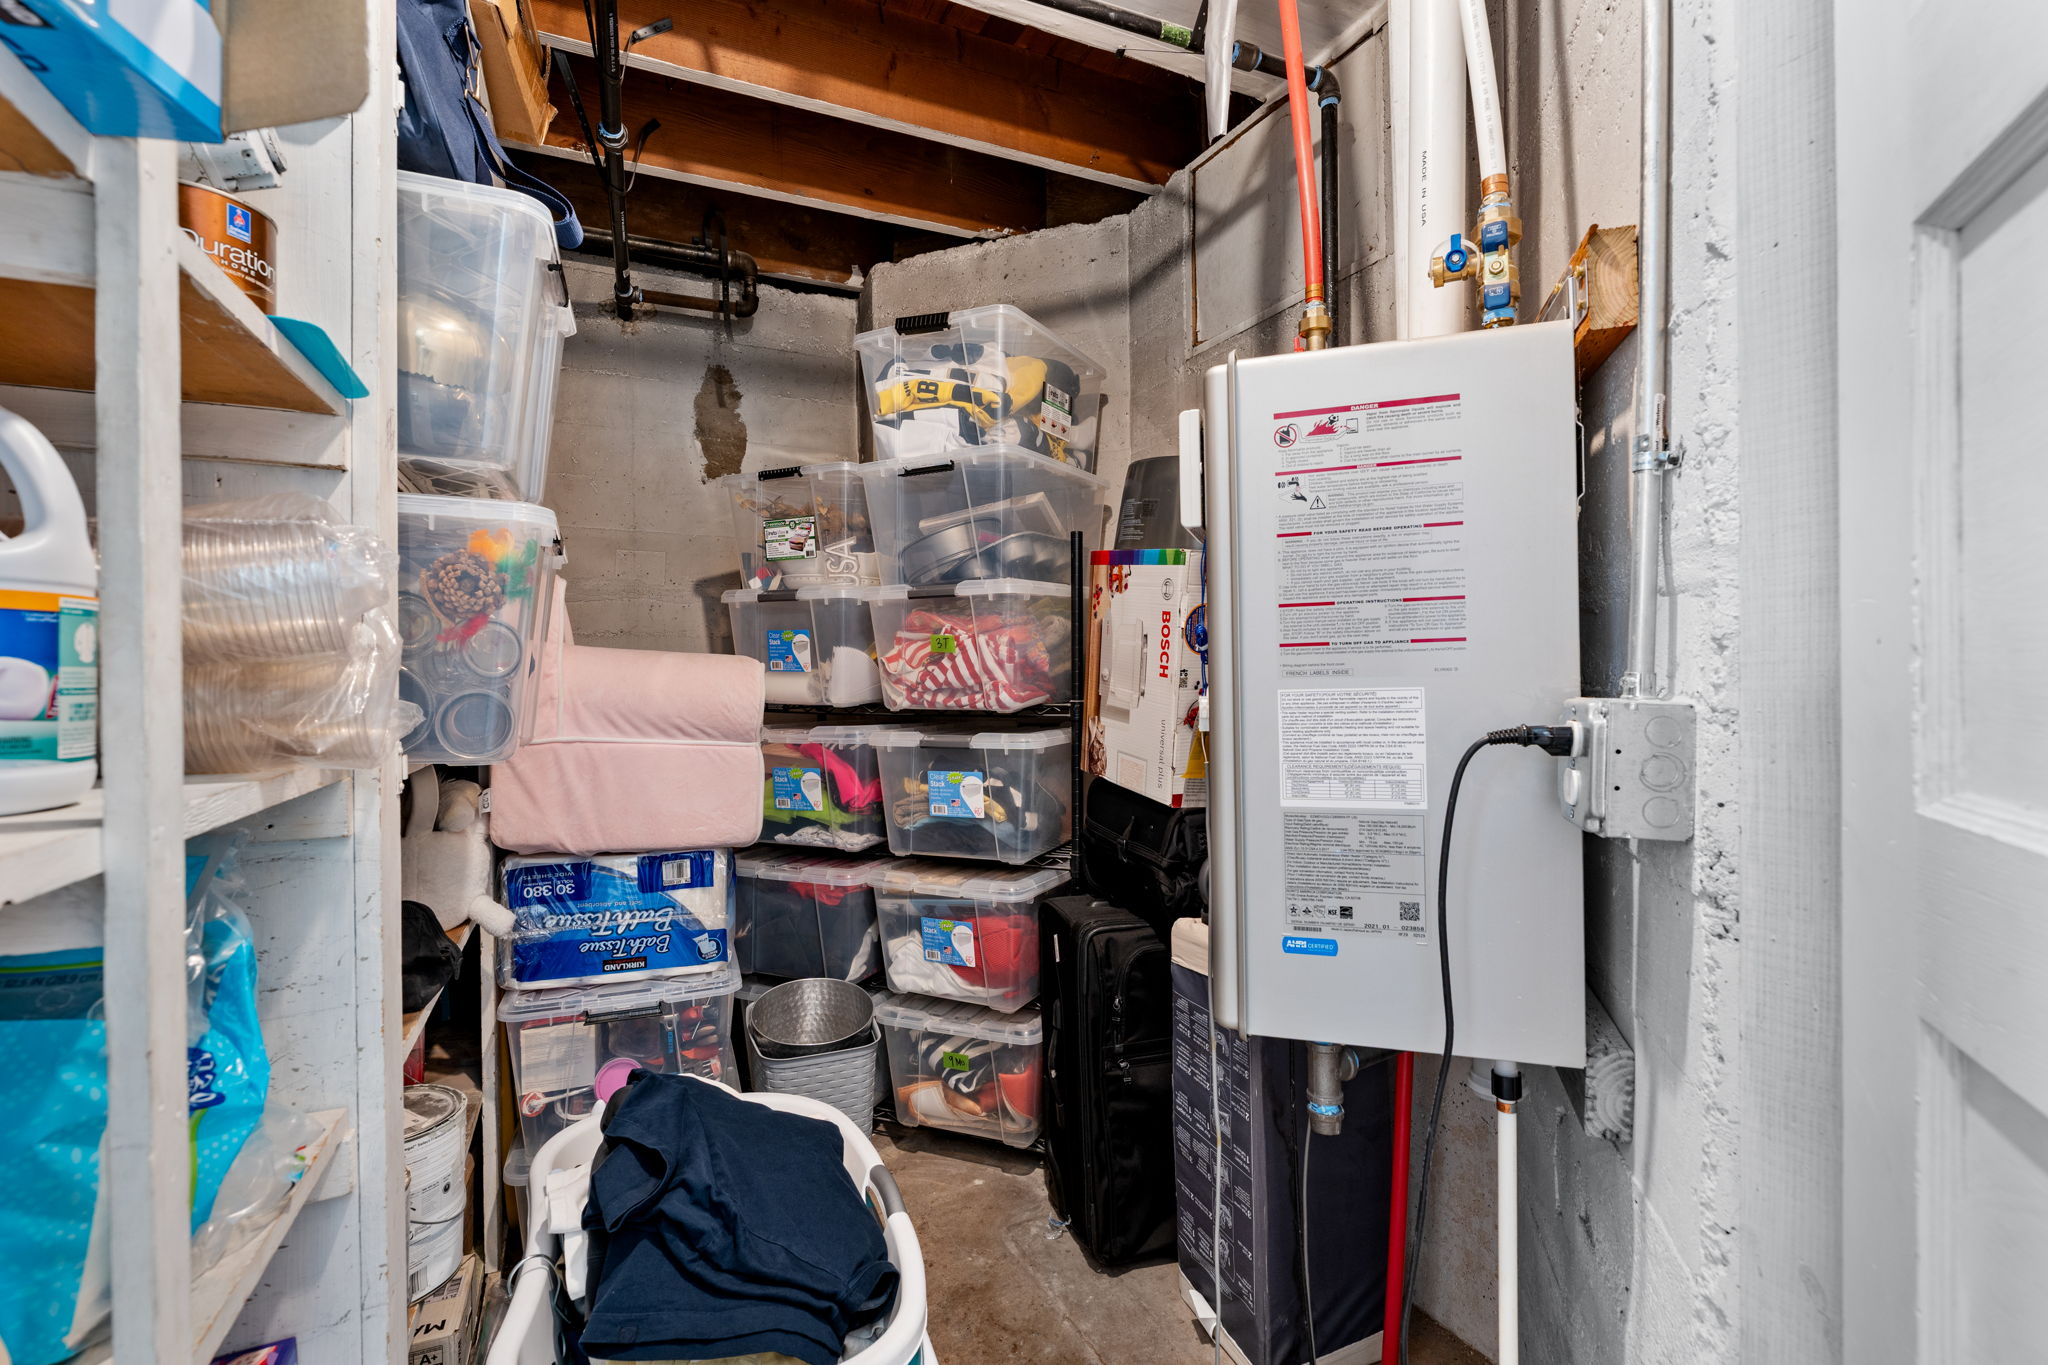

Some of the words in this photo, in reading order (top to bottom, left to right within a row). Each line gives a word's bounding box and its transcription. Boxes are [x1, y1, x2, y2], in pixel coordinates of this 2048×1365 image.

[1421, 187, 1427, 199] IN
[220, 258, 256, 276] HOME
[1350, 403, 1379, 411] DANGER
[935, 637, 950, 649] 3T
[1159, 611, 1171, 679] BOSCH
[1158, 719, 1166, 765] universal
[523, 886, 553, 899] 380
[556, 883, 576, 895] 30
[577, 901, 612, 909] Absorbent
[543, 914, 614, 937] Tissue
[612, 907, 674, 933] Bath
[578, 937, 628, 958] Tissue
[626, 934, 670, 953] Bath
[604, 960, 646, 971] KIRKLAND
[948, 1056, 954, 1066] 9
